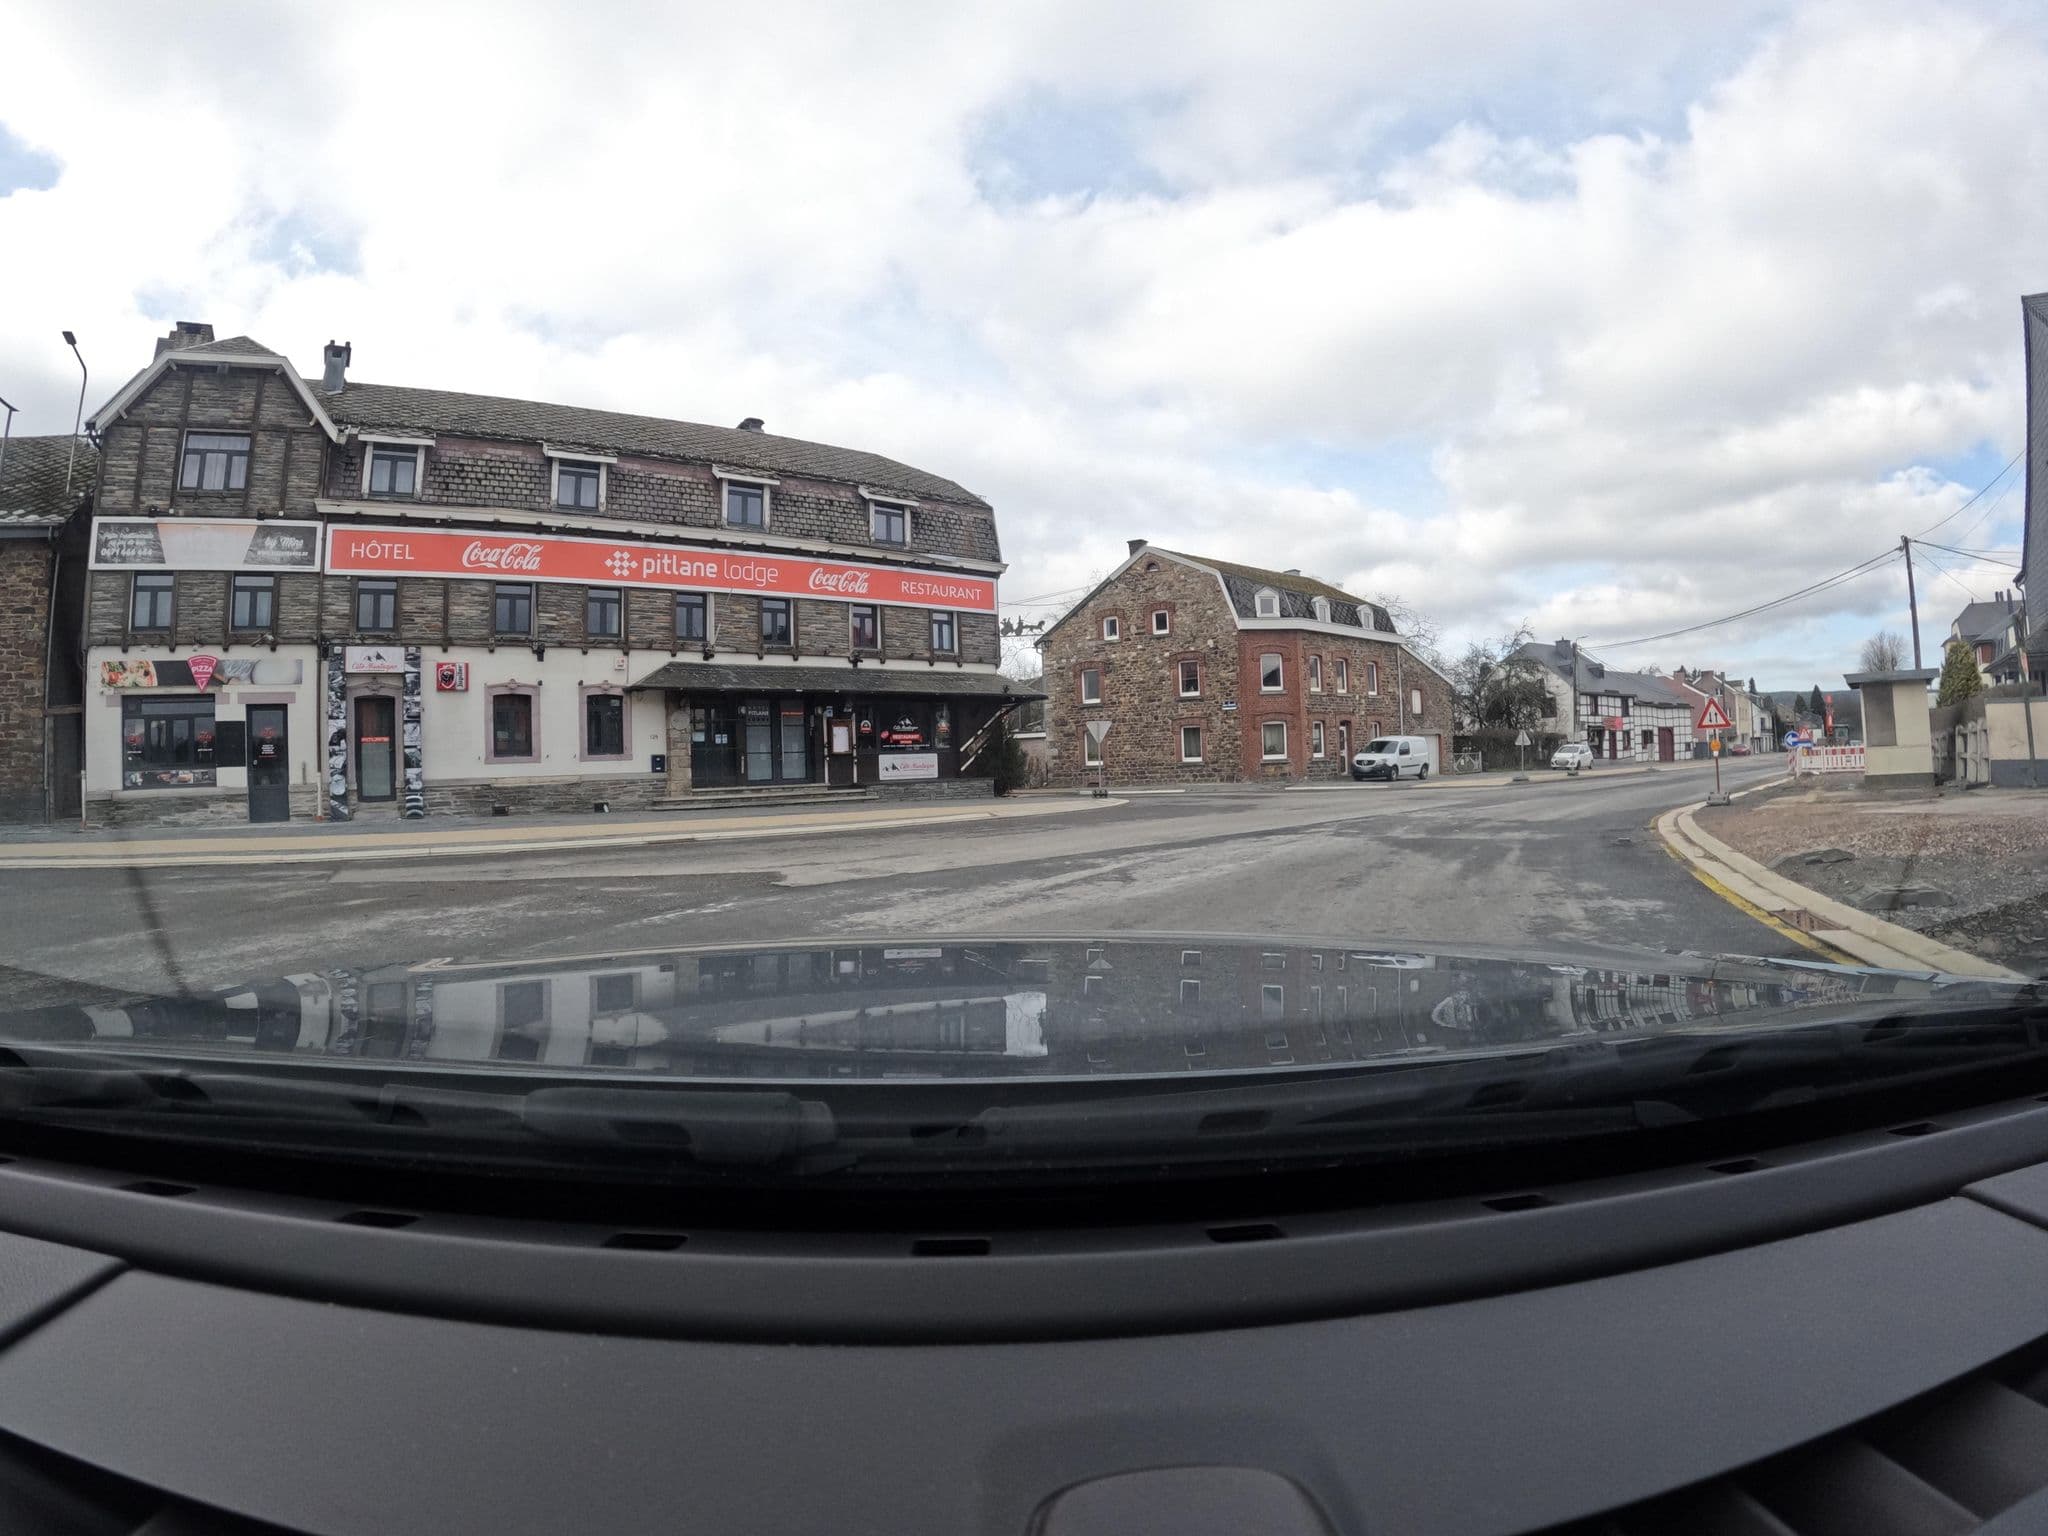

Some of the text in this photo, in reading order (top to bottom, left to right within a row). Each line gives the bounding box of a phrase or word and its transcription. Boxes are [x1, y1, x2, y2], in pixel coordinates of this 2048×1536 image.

[350, 540, 414, 560] HÔTEL
[462, 541, 544, 570] Coca-Cola
[642, 555, 779, 588] pitlane lodge
[808, 567, 870, 594] Coca-Cola
[901, 580, 982, 600] RESTAURANT
[191, 665, 213, 673] PIZZA
